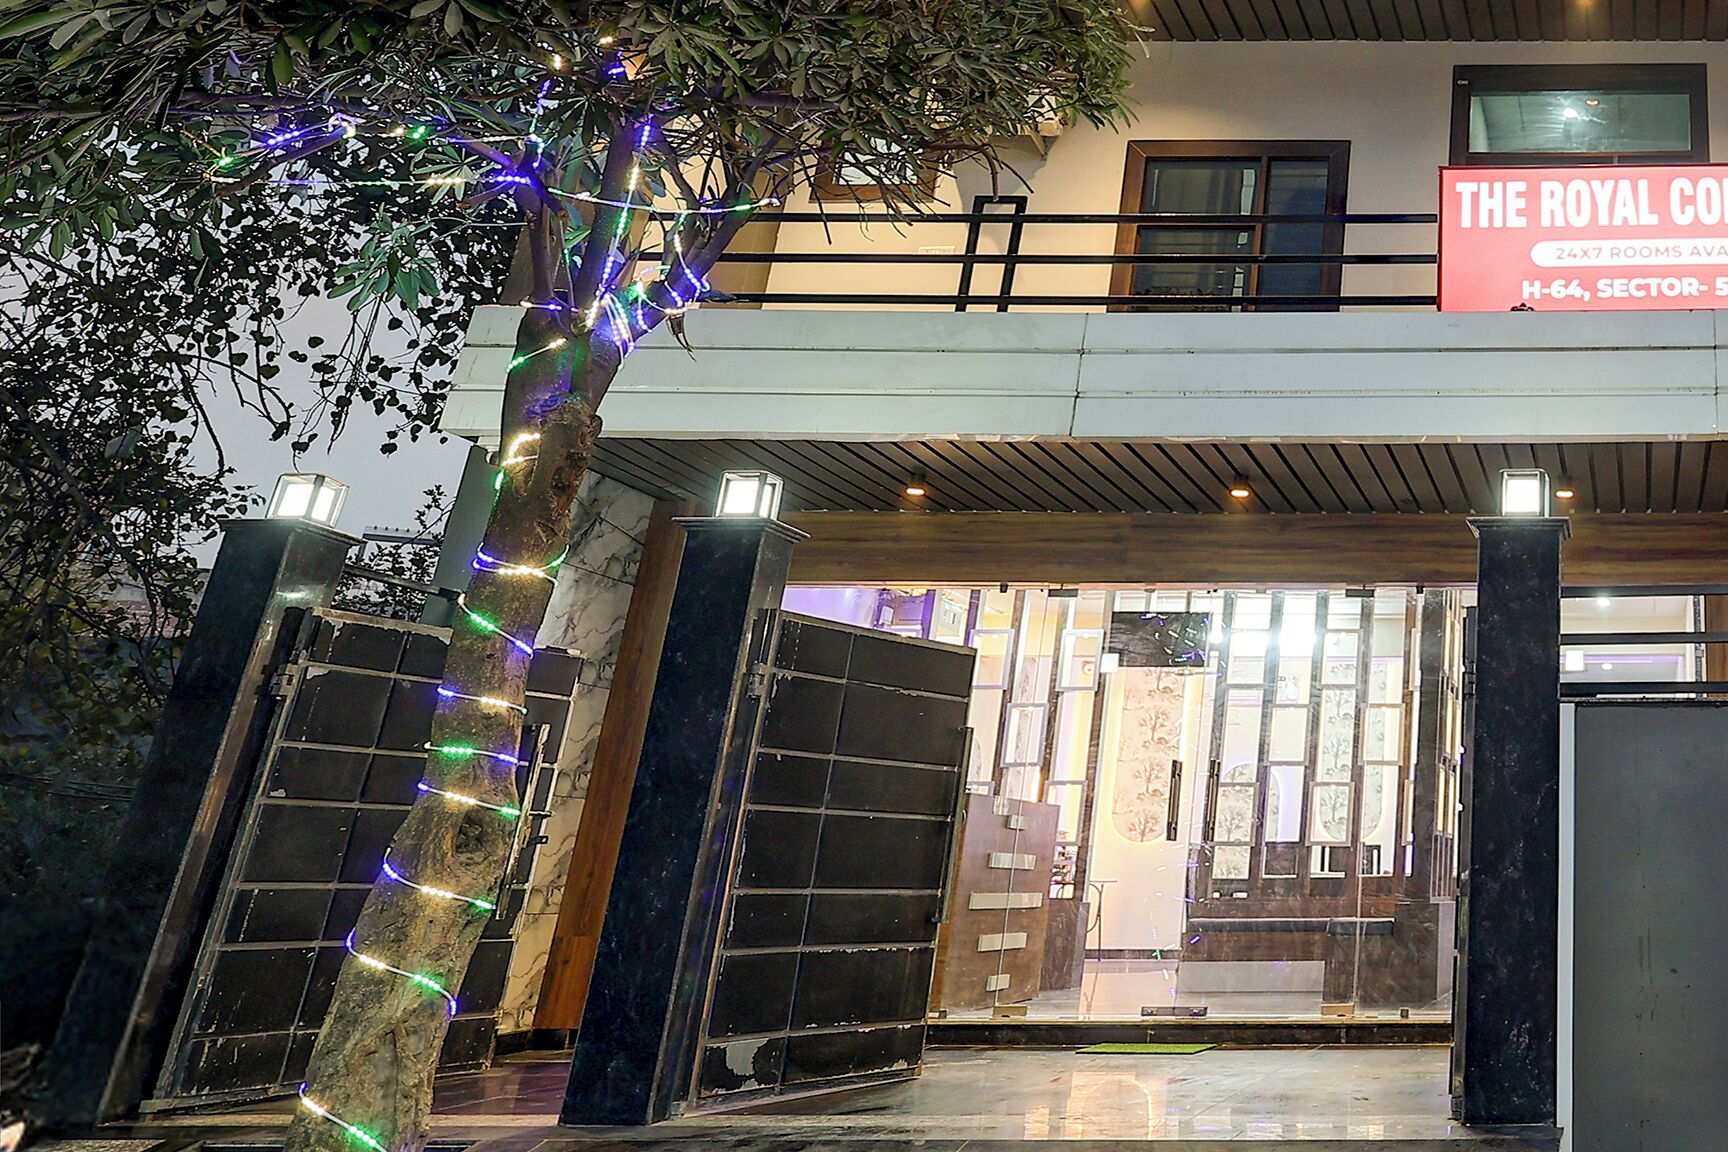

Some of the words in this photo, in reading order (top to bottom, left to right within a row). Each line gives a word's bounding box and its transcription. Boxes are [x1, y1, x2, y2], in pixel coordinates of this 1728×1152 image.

[1455, 181, 1527, 228] THE
[1540, 178, 1659, 228] ROYAL
[1555, 247, 1602, 260] 24X7
[1610, 245, 1682, 259] ROOMS
[1522, 279, 1591, 302] H-64,
[1596, 276, 1709, 298] SECTOR-
